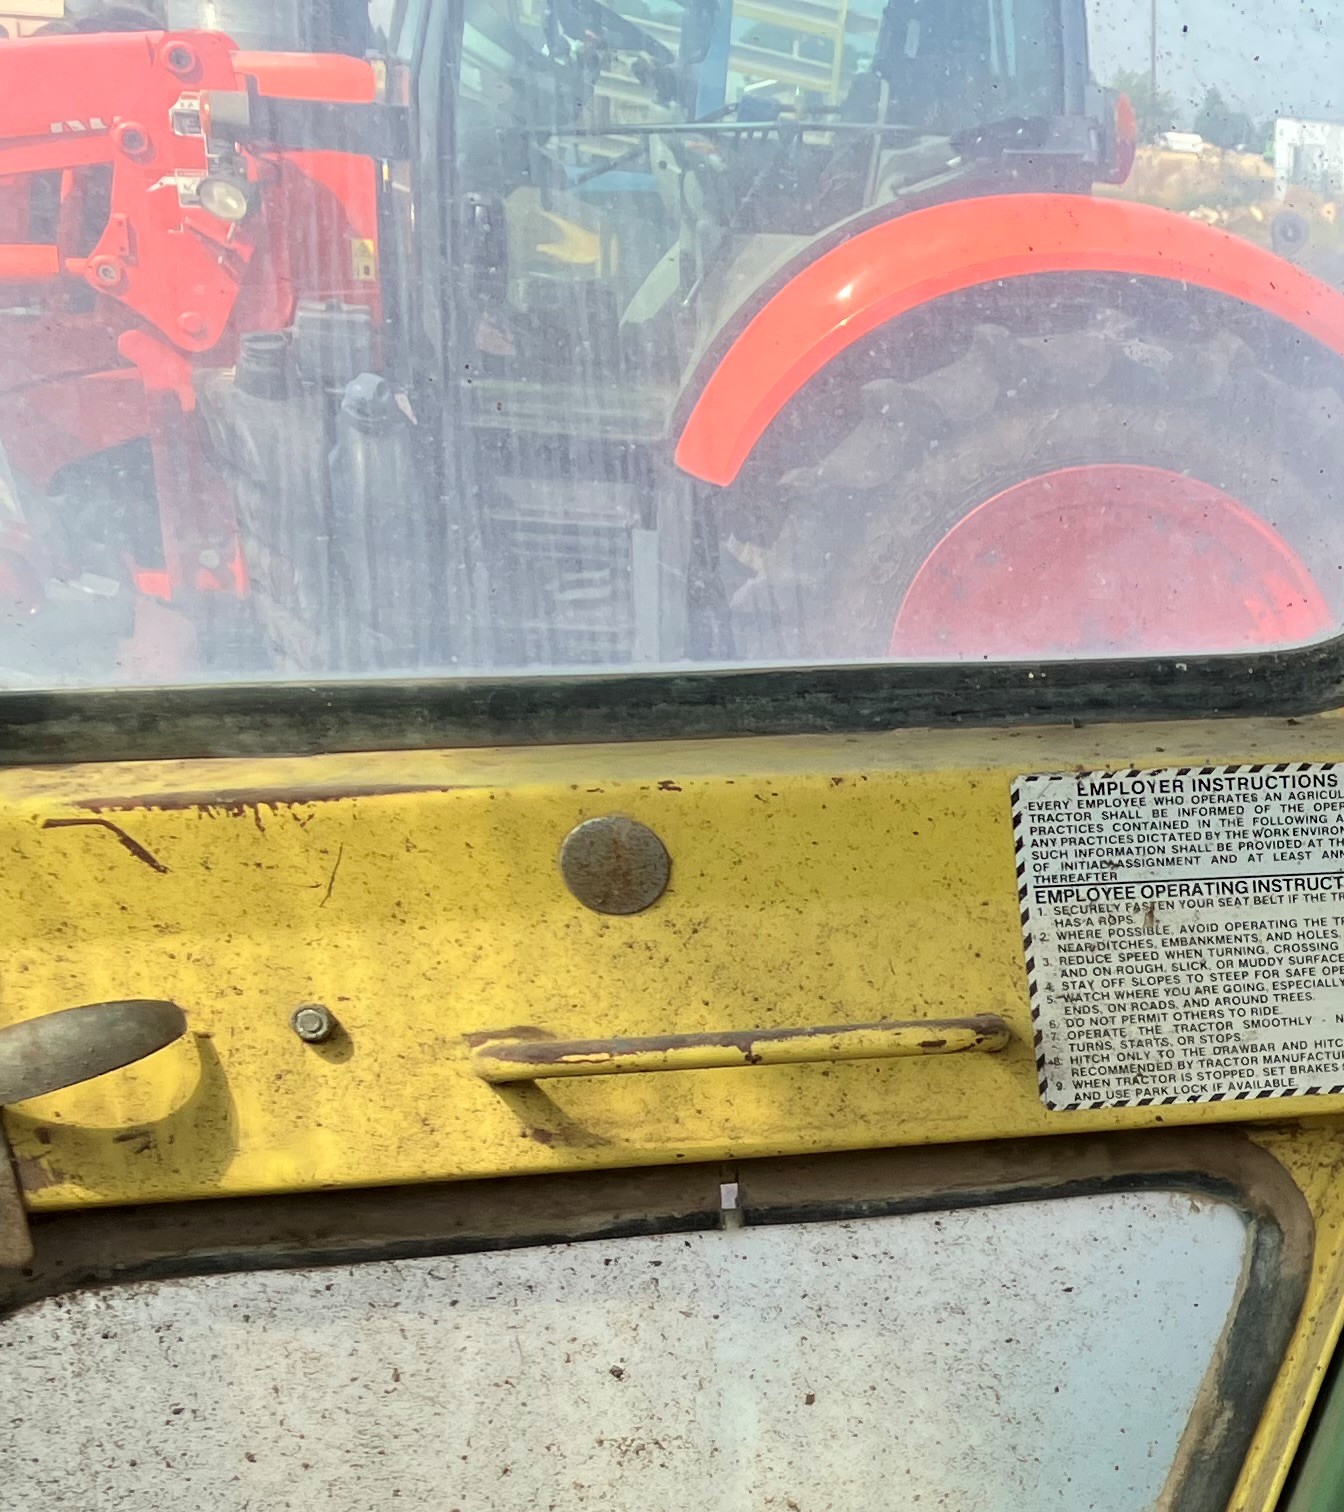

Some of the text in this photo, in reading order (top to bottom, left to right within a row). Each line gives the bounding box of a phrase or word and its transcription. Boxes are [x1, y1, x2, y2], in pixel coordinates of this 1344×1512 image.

[1076, 773, 1338, 796] EMPLOYER INSTRUCTIONS
[1028, 800, 1070, 810] EVERY
[1077, 796, 1147, 809] EMPLOYEE
[1153, 795, 1184, 805] WHO
[1191, 793, 1258, 804] OPERATES
[1264, 792, 1283, 801] AN
[1029, 811, 1092, 823] TRACTOR
[1101, 810, 1142, 820] SHALL
[1152, 809, 1168, 818] BE
[1177, 805, 1244, 816] INFORMED
[1254, 804, 1271, 814] OF
[1280, 803, 1304, 813] THE
[1029, 823, 1104, 835] PRACTICES
[1112, 820, 1189, 832] CONTAINED
[1198, 819, 1211, 828] IN
[1220, 817, 1244, 827] THE
[1252, 814, 1328, 826] FOLLOWING
[1030, 838, 1057, 848] ANY
[1060, 834, 1134, 846] PRACTICES
[1137, 832, 1202, 842] DICTATED
[1205, 830, 1221, 840] BY
[1225, 829, 1249, 839] THE
[1252, 827, 1290, 838] WORK
[1031, 849, 1069, 860] SUCH
[1074, 845, 1166, 858] INFORMATION
[1171, 843, 1211, 853] SHALL
[1217, 842, 1233, 851] BE
[1238, 839, 1303, 850] PROVIDED
[1307, 838, 1324, 847] AT
[1032, 862, 1050, 872] OF
[1116, 856, 1202, 868] ASSIGNMENT
[1210, 854, 1238, 863] AND
[1247, 853, 1264, 862] AT
[1273, 851, 1312, 861] LEAST
[1033, 871, 1118, 884] THEREAFTER
[1035, 885, 1136, 903] EMPLOYEE
[1140, 880, 1249, 898] OPERATING
[1053, 902, 1121, 915] SECURELY
[1125, 900, 1175, 911] FASTEN
[1178, 898, 1214, 908] YOUR
[1218, 896, 1251, 907] SEAT
[1253, 894, 1285, 904] BELT
[1288, 894, 1299, 903] IF
[1303, 893, 1328, 902] THE
[1054, 914, 1136, 927] HAS A ROPS.
[1056, 929, 1103, 940] WHERE
[1179, 923, 1219, 933] AVOID
[1224, 919, 1298, 931] OPERATING
[1304, 917, 1328, 927] THE
[1058, 942, 1093, 953] NEAR
[1265, 931, 1293, 941] AND
[1297, 929, 1341, 939] HOLES.
[1059, 954, 1113, 965] REDUCE
[1118, 951, 1159, 962] SPEED
[1165, 949, 1203, 959] WHEN
[1273, 941, 1339, 953] CROSSING
[1060, 967, 1089, 977] AND
[1092, 966, 1113, 976] ON
[1216, 959, 1234, 969] OR
[1238, 957, 1285, 967] MUDDY
[1062, 980, 1095, 990] STAY
[1101, 978, 1126, 987] OFF
[1131, 975, 1181, 986] SLOPES
[1186, 973, 1204, 983] TO
[1209, 971, 1250, 981] STEEP
[1254, 969, 1280, 979] FOR
[1285, 967, 1316, 977] SAFE
[1063, 991, 1110, 1003] WATCH
[1114, 988, 1160, 999] WHERE
[1164, 986, 1191, 996] YOU
[1194, 985, 1219, 994] ARE
[1107, 1003, 1127, 1012] ON
[1182, 997, 1210, 1008] AND
[1214, 994, 1269, 1006] AROUND
[1273, 991, 1315, 1002] TREES.
[1066, 1017, 1086, 1028] DO
[1089, 1016, 1118, 1025] NOT
[1121, 1012, 1169, 1024] PERMIT
[1173, 1009, 1225, 1021] OTHERS
[1229, 1007, 1246, 1017] TO
[1067, 1027, 1127, 1040] OPERATE
[1138, 1025, 1164, 1036] THE
[1173, 1021, 1233, 1033] TRACTOR
[1243, 1016, 1313, 1028] SMOOTHLY
[1177, 1035, 1195, 1045] OR
[1199, 1032, 1244, 1043] STOPS.
[1070, 1053, 1110, 1064] HITCH
[1116, 1050, 1151, 1061] ONLY
[1158, 1049, 1175, 1058] TO
[1182, 1046, 1207, 1057] THE
[1212, 1042, 1276, 1055] DRAWBAR
[1281, 1041, 1308, 1050] AND
[1071, 1060, 1173, 1076] RECOMMENDED
[1177, 1059, 1194, 1069] BY
[1198, 1055, 1258, 1068] TRACTOR
[1072, 1078, 1111, 1089] WHEN
[1115, 1073, 1177, 1086] TRACTOR
[1181, 1072, 1193, 1081] IS
[1263, 1066, 1286, 1076] SET
[1289, 1063, 1340, 1074] BRAKES
[1074, 1091, 1102, 1101] AND
[1106, 1088, 1133, 1099] USE
[1135, 1086, 1170, 1097] PARK
[1173, 1084, 1208, 1094] LOCK
[1212, 1082, 1224, 1091] IF
